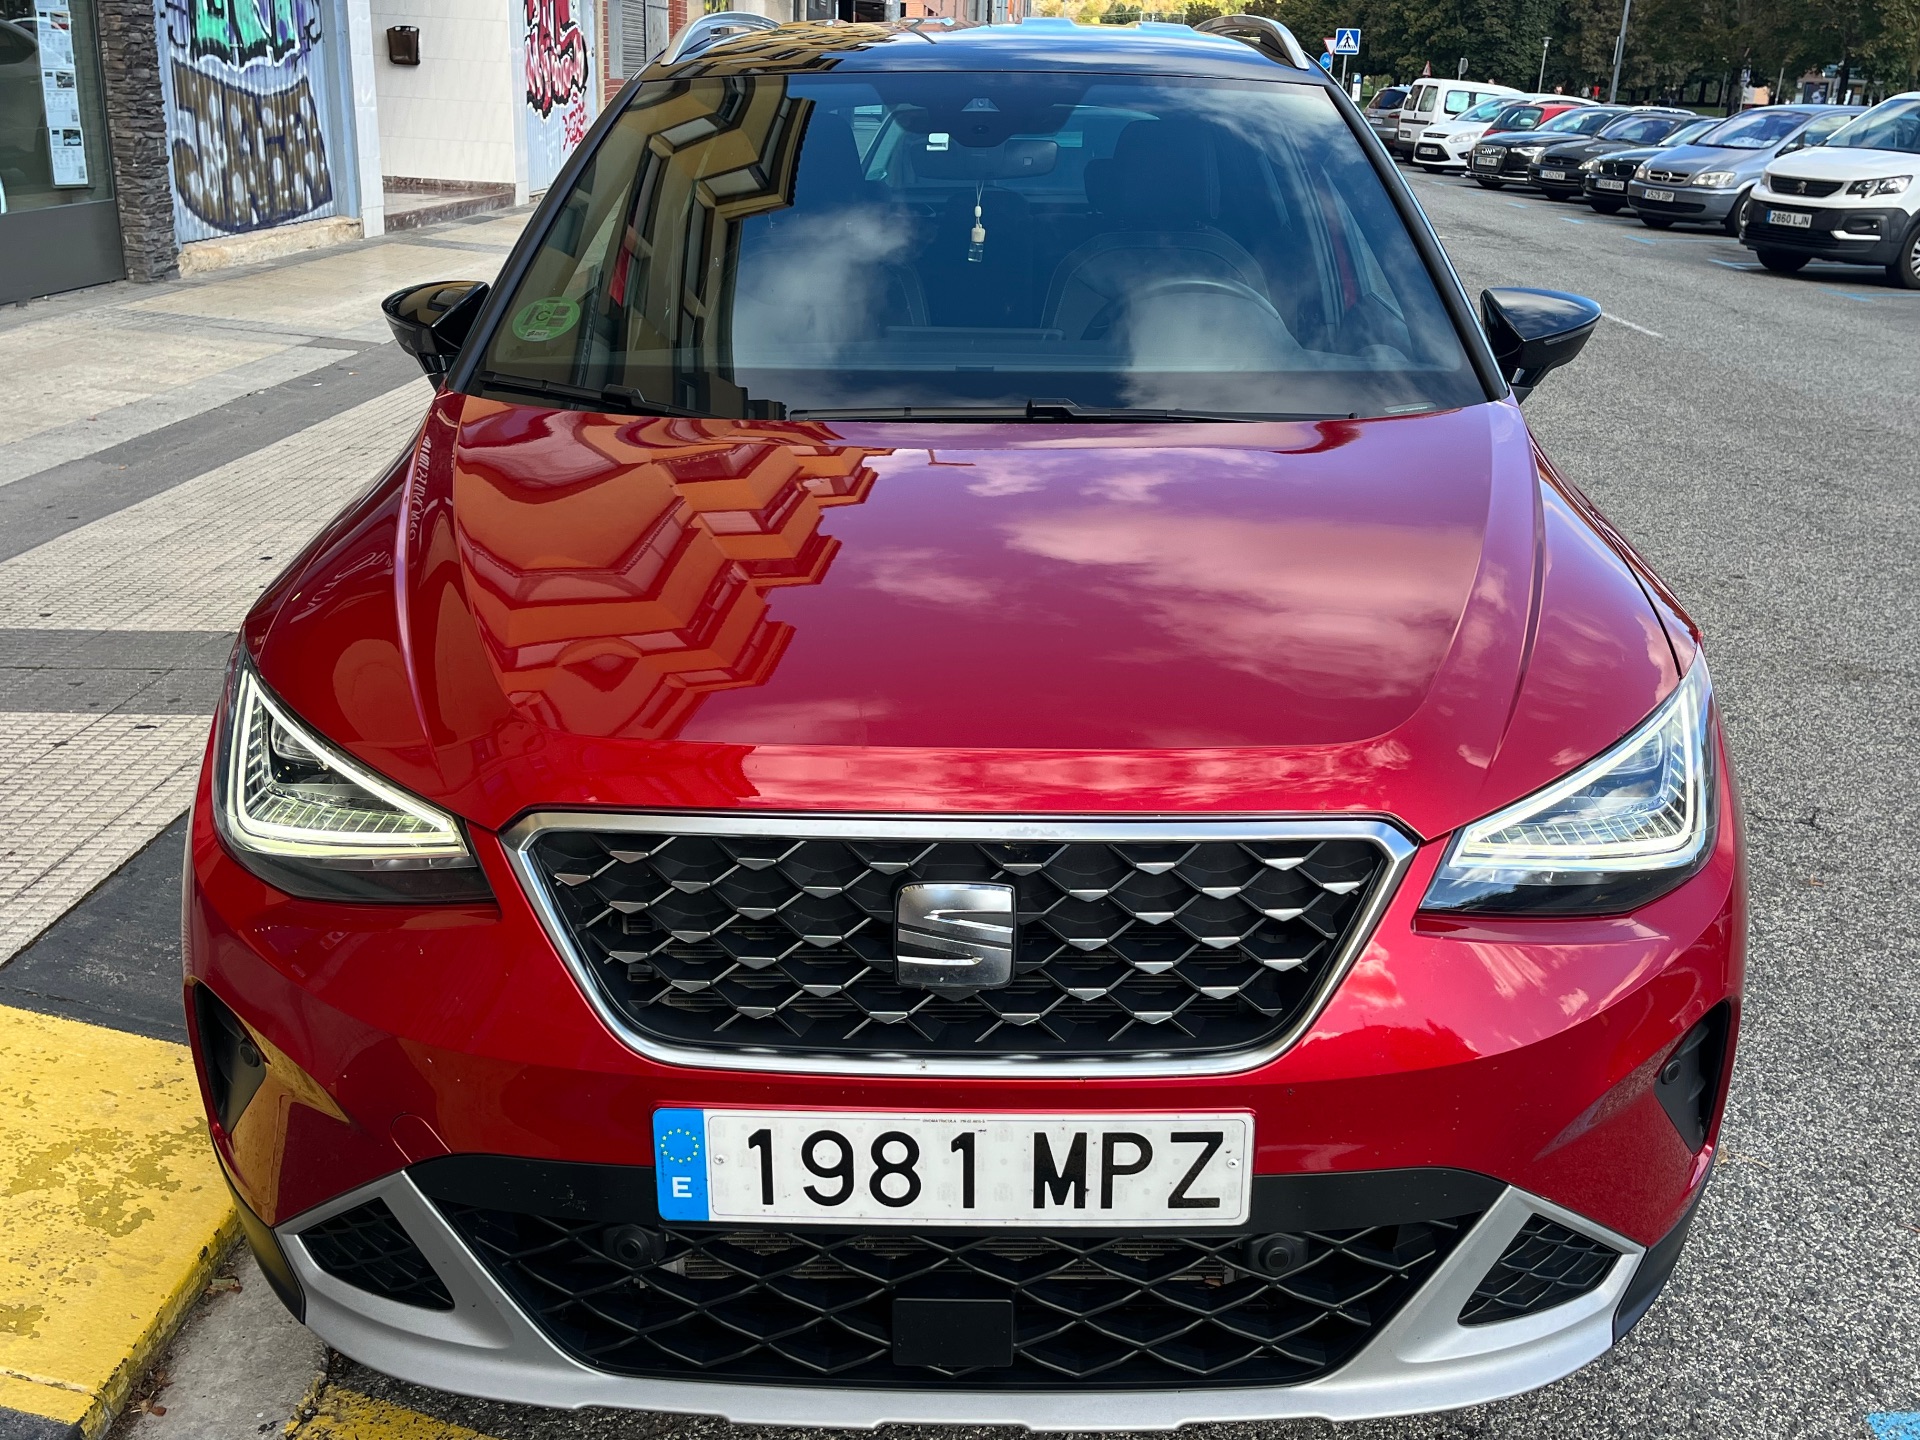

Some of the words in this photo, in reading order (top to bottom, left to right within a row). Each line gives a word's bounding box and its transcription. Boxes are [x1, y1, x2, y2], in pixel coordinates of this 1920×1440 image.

[1771, 212, 1791, 223] 2860
[1792, 214, 1810, 226] LJN
[536, 311, 551, 321] C
[746, 1127, 976, 1209] 1981
[1031, 1131, 1225, 1211] MPZ
[671, 1176, 693, 1198] E
